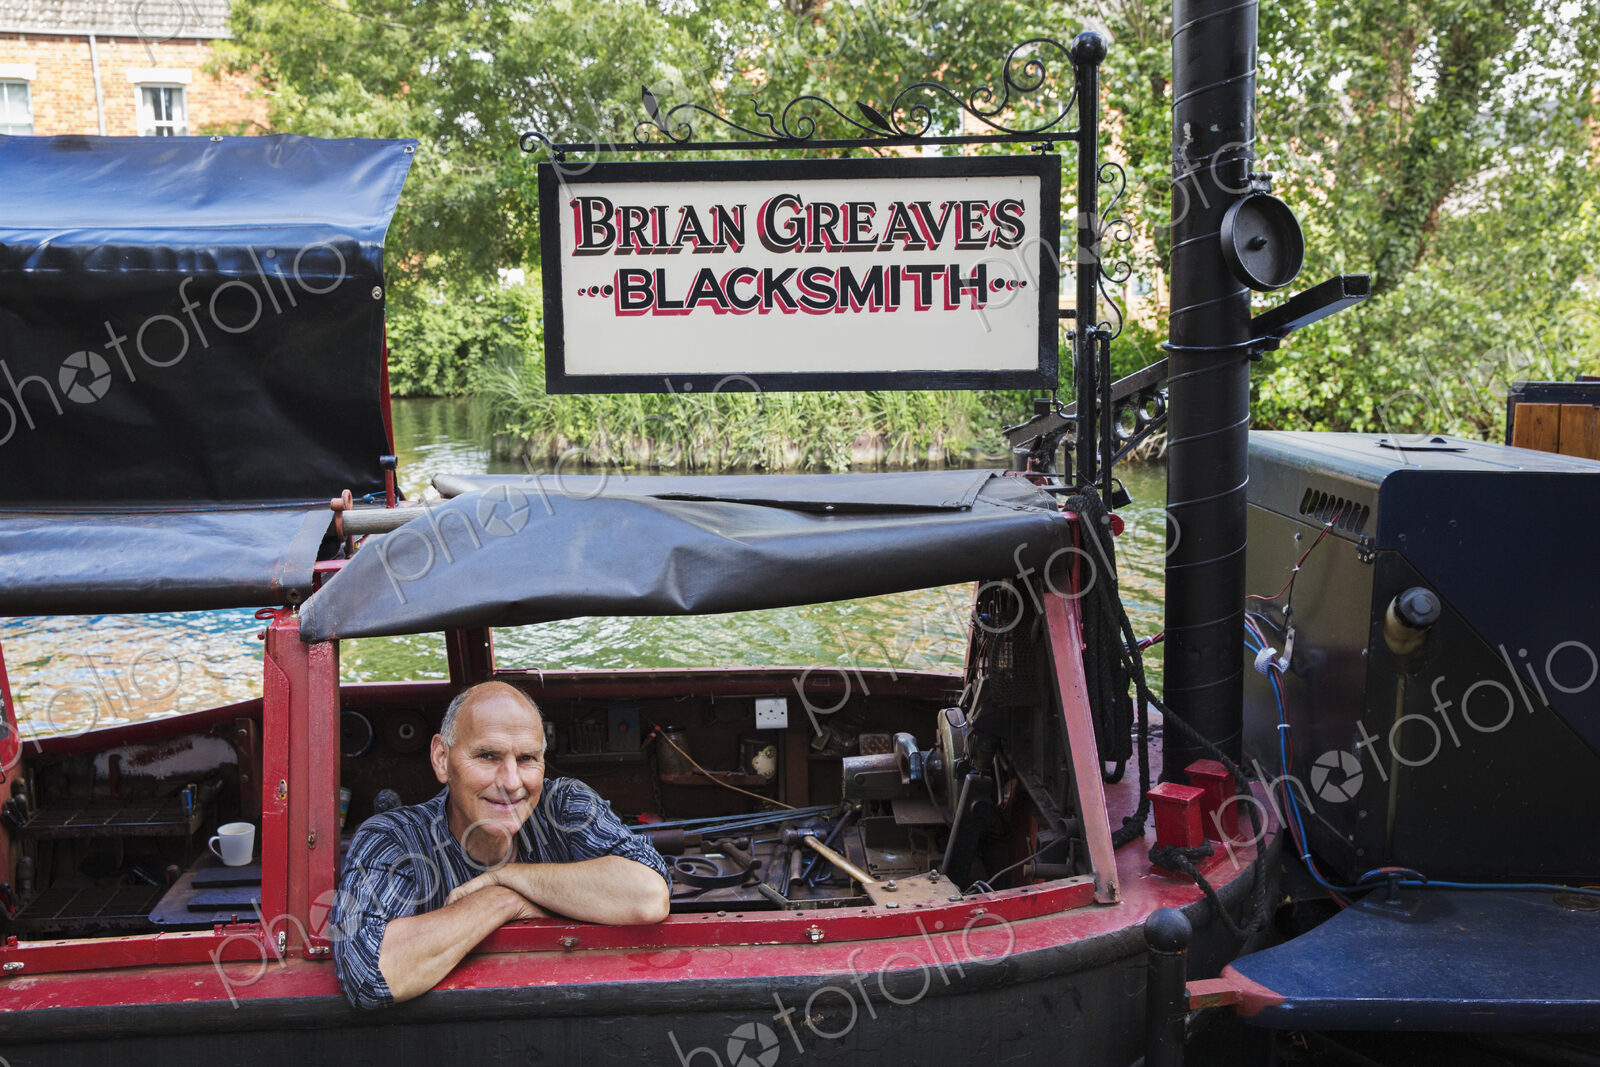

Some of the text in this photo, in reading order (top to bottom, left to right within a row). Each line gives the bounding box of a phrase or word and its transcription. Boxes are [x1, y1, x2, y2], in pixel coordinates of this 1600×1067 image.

[572, 193, 1027, 256] BRIAN GREAVES
[614, 263, 988, 317] BLACKSMITH
